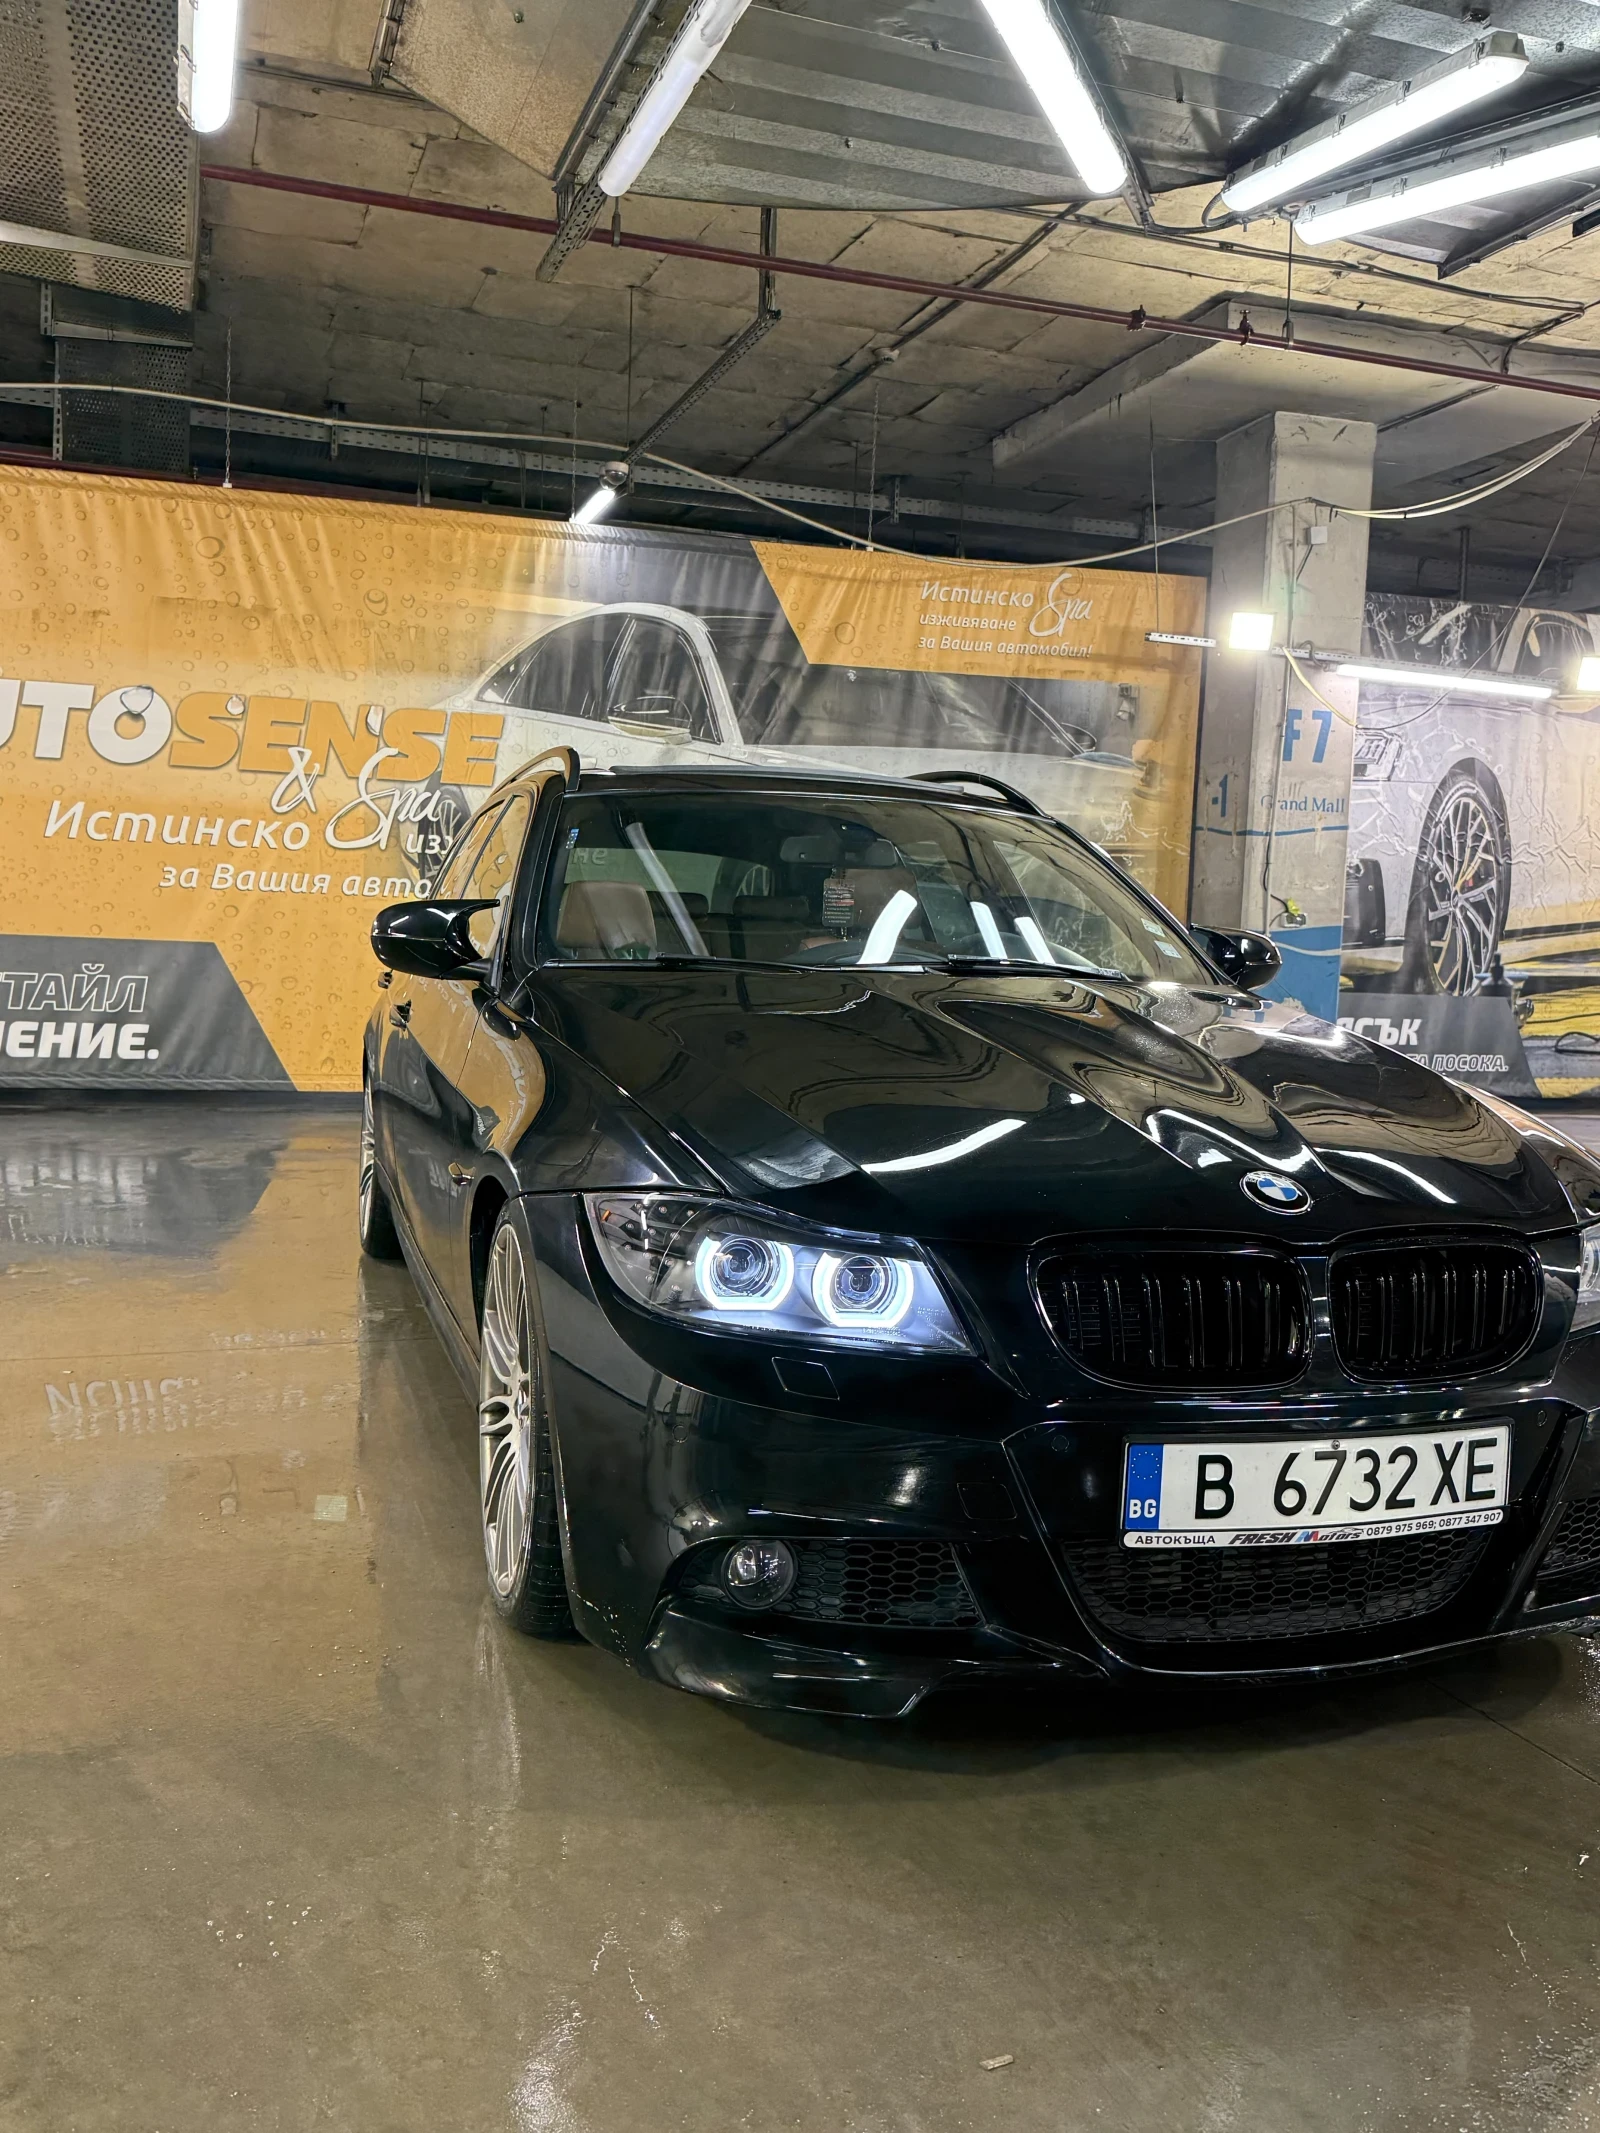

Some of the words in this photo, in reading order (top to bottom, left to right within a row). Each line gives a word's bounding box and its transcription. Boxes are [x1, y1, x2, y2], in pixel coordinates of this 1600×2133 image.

[919, 613, 1017, 631] изживяване
[921, 581, 1034, 608] Истинско
[1029, 573, 1093, 637] Spa
[918, 636, 935, 649] за
[940, 635, 993, 653] Вашия
[997, 639, 1093, 658] автомобил!
[271, 747, 320, 813] &
[325, 747, 441, 850] Spa
[1211, 774, 1228, 817] -1
[1312, 797, 1345, 813] Mall
[44, 800, 310, 850] Истинско
[160, 866, 198, 889] за
[211, 863, 329, 894] Вашия
[0, 963, 148, 1012] ТАЙЛ
[0, 1021, 160, 1060] ЕНИЕ.
[1194, 1454, 1235, 1520] B
[1273, 1446, 1418, 1516] 6732
[1430, 1437, 1498, 1506] XE
[1128, 1499, 1157, 1519] BG
[1135, 1534, 1216, 1545] АВТОКЪЩА
[1228, 1532, 1297, 1545] FRESH
[1366, 1525, 1392, 1536] 0879
[1395, 1523, 1413, 1533] 975
[1415, 1520, 1437, 1531] 969;
[1438, 1516, 1463, 1528] 0877
[1464, 1514, 1482, 1525] 347
[1483, 1512, 1501, 1523] 907
